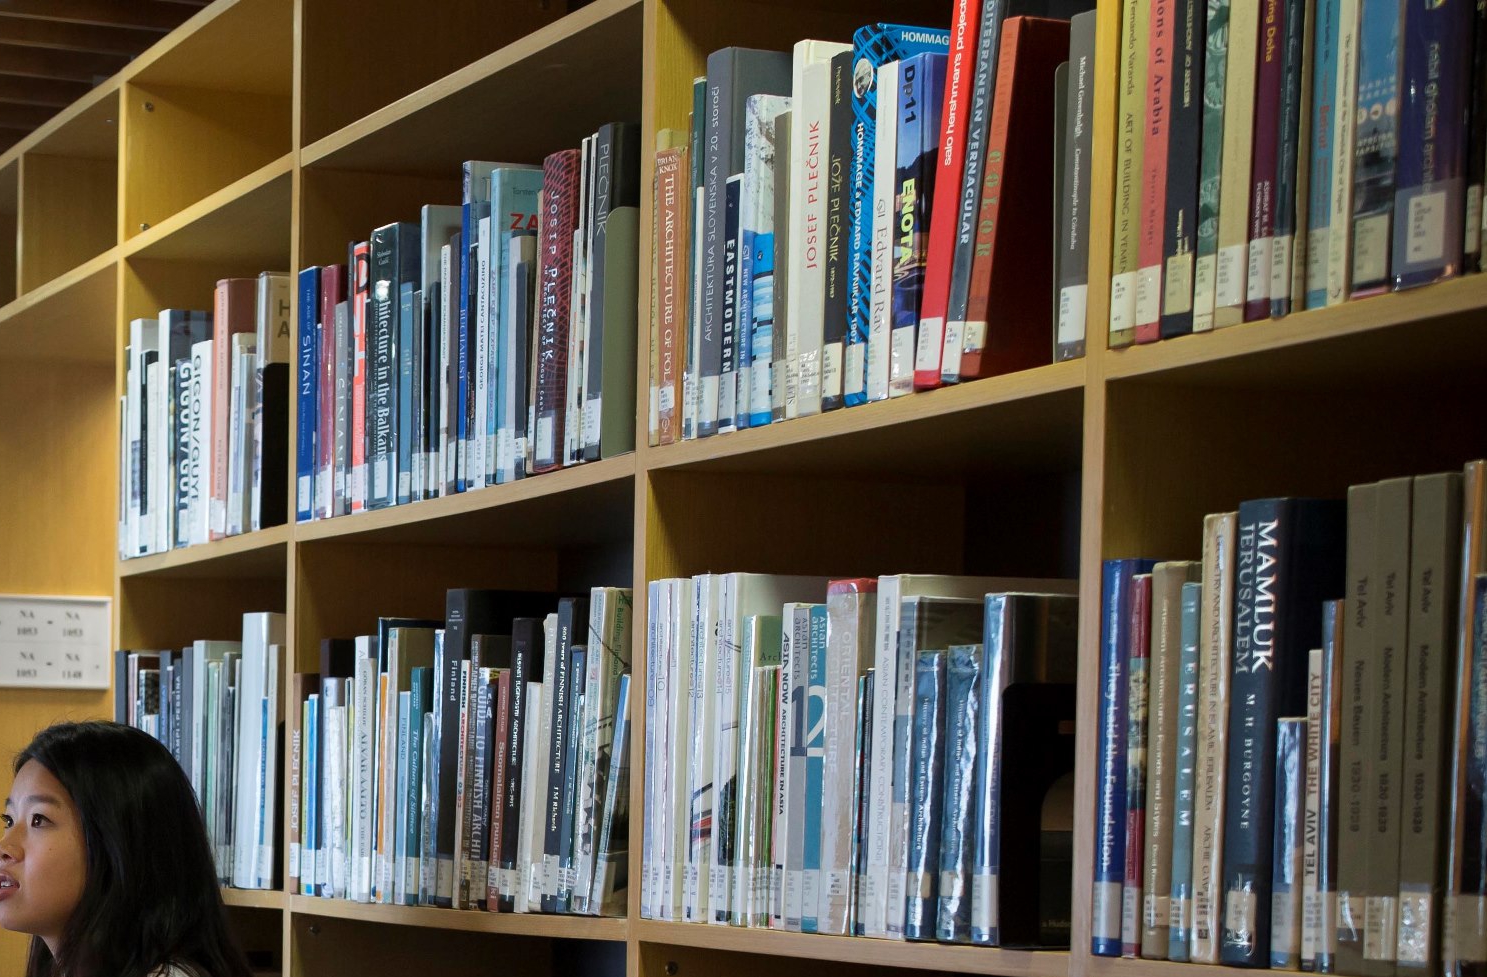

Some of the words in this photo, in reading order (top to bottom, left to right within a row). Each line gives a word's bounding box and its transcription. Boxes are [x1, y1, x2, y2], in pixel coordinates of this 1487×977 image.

[1265, 28, 1276, 63] Doha
[946, 52, 962, 134] hershman's
[1078, 56, 1087, 94] Michael
[1125, 112, 1133, 133] ART
[1151, 74, 1163, 137] Arabia
[656, 155, 678, 165] BRIAN
[658, 164, 679, 175] KNOX
[804, 120, 820, 204] PLEČNIK
[856, 122, 865, 188] HOMMAGE
[944, 135, 954, 166] salo
[1124, 134, 1132, 150] OF
[597, 143, 611, 237] PLEČNIK
[664, 174, 674, 209] THE
[830, 154, 843, 193] JOŽE
[960, 128, 980, 245] VERNACULAR
[1121, 158, 1132, 217] BUILDING
[548, 190, 560, 255] JOSIP
[707, 169, 717, 243] SLOVENSKA
[828, 198, 841, 262] PLEČNIK
[854, 195, 862, 252] EDVARD
[899, 177, 916, 265] ENOTA
[664, 210, 674, 325] ARCHITECTURE
[806, 213, 818, 269] JOSEF
[873, 225, 888, 299] Edvard
[1119, 230, 1128, 274] YEMEN
[545, 266, 558, 360] PLEČNIK
[703, 244, 717, 342] ARCHITEKTÚRA
[722, 238, 736, 373] EASTMODERN
[851, 252, 861, 322] RAVNIKAR
[663, 328, 673, 347] OF
[740, 287, 749, 349] ARCHITECTURE
[302, 335, 311, 395] SINAN
[377, 366, 390, 380] in
[377, 382, 390, 407] the
[376, 408, 390, 462] Balkans
[1235, 523, 1255, 675] JERUSALEM
[1251, 518, 1279, 674] MAMLUK
[1356, 576, 1369, 600] Tel
[1385, 573, 1397, 592] Tel
[1421, 566, 1433, 588] Tel
[1354, 600, 1366, 630] Aviv
[782, 632, 790, 670] ASIA
[839, 630, 852, 722] ORIENTAL
[881, 656, 890, 688] ASIAN
[1381, 646, 1394, 691] Modern
[1417, 643, 1429, 688] Modern
[449, 660, 458, 702] Finland
[557, 671, 566, 707] FINNISH
[780, 672, 789, 705] NOW
[1310, 672, 1321, 706] CITY
[1353, 659, 1365, 704] Neues
[554, 707, 564, 774] ARCHITECTURE
[780, 708, 788, 768] ARCHITECTURE
[806, 684, 827, 758] 2
[879, 689, 889, 774] CONTEMPORARY
[1178, 642, 1198, 828] JERUSALEM
[1309, 708, 1320, 765] WHITE
[1352, 705, 1363, 748] Bauen
[1378, 692, 1392, 762] Architecture
[1415, 689, 1428, 761] Architecture
[494, 741, 505, 818] Suomalainen
[1240, 738, 1254, 830] BURGOYNE
[1307, 766, 1318, 796] THE
[290, 787, 300, 832] JOSEF
[916, 803, 924, 851] Architecture
[1101, 774, 1118, 867] Foundation
[1305, 808, 1317, 848] AVIV
[1304, 850, 1316, 877] TEL
